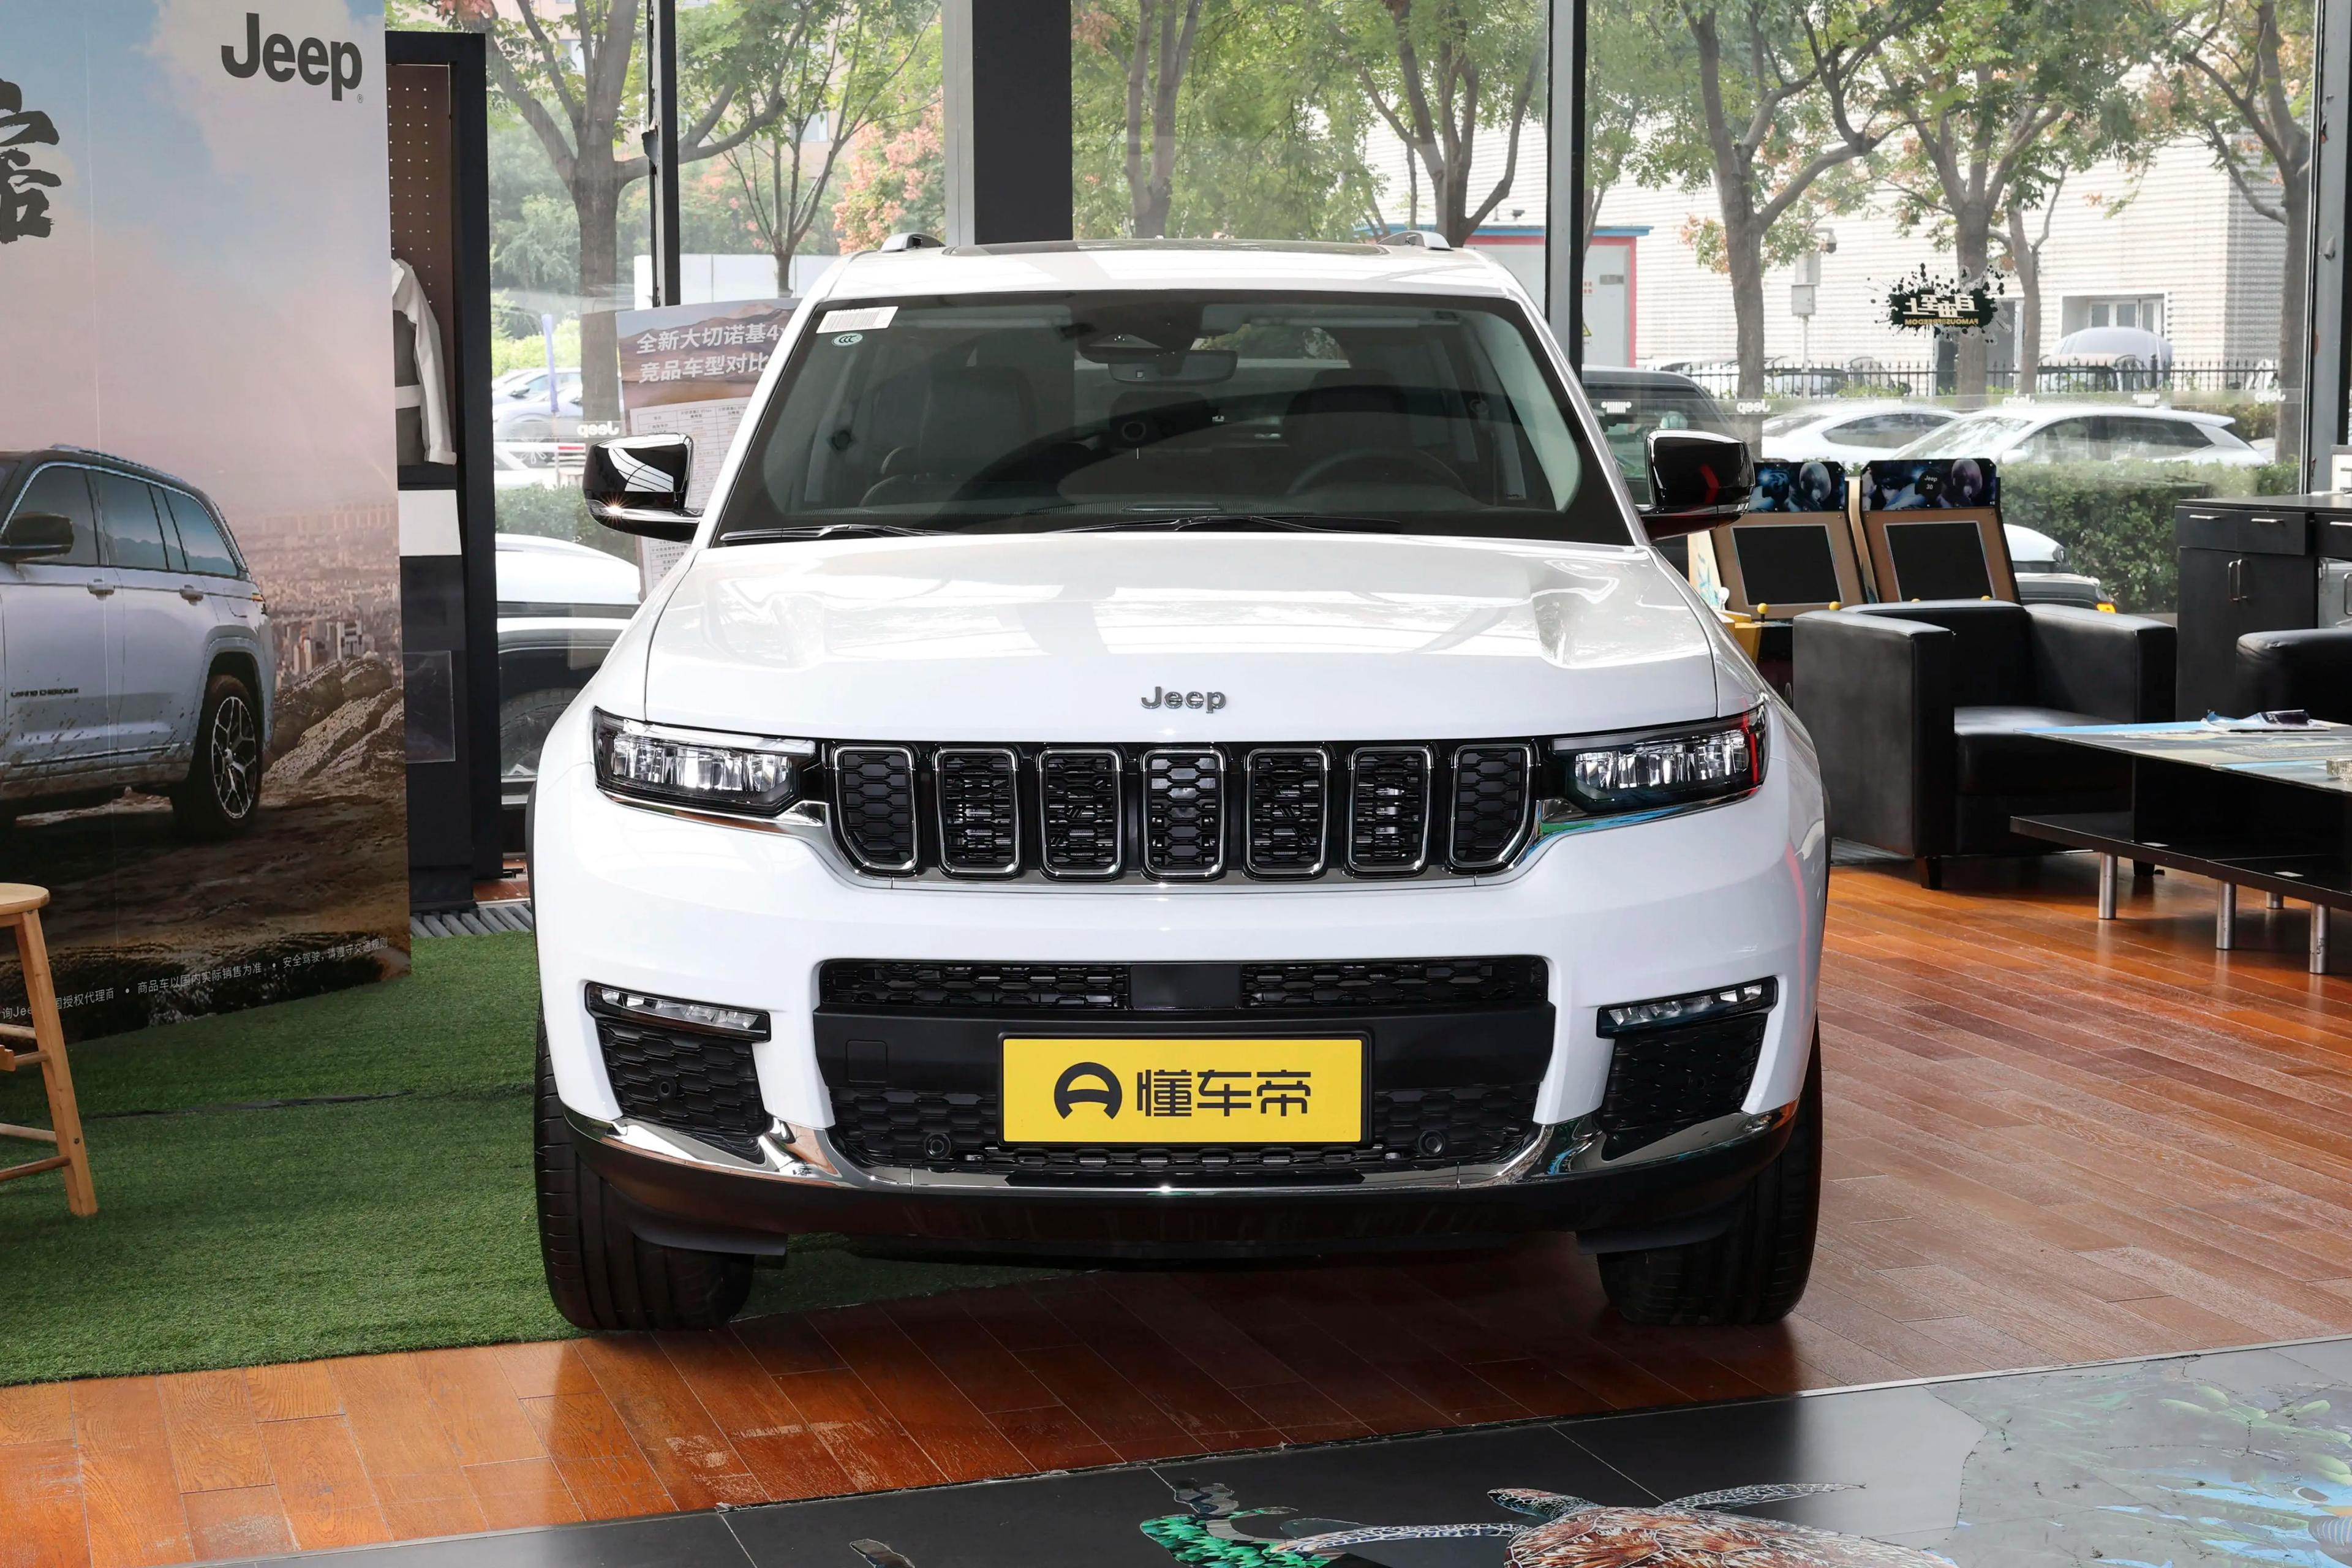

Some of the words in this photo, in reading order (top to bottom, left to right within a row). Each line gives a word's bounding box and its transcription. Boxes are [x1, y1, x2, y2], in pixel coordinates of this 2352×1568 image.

[221, 12, 363, 102] Jeep
[638, 352, 770, 383] 竞品车型对比
[1141, 686, 1226, 714] Jeep
[137, 962, 262, 994] 商品车以国内实际销售为准
[1137, 1069, 1311, 1117] 懂车帝
